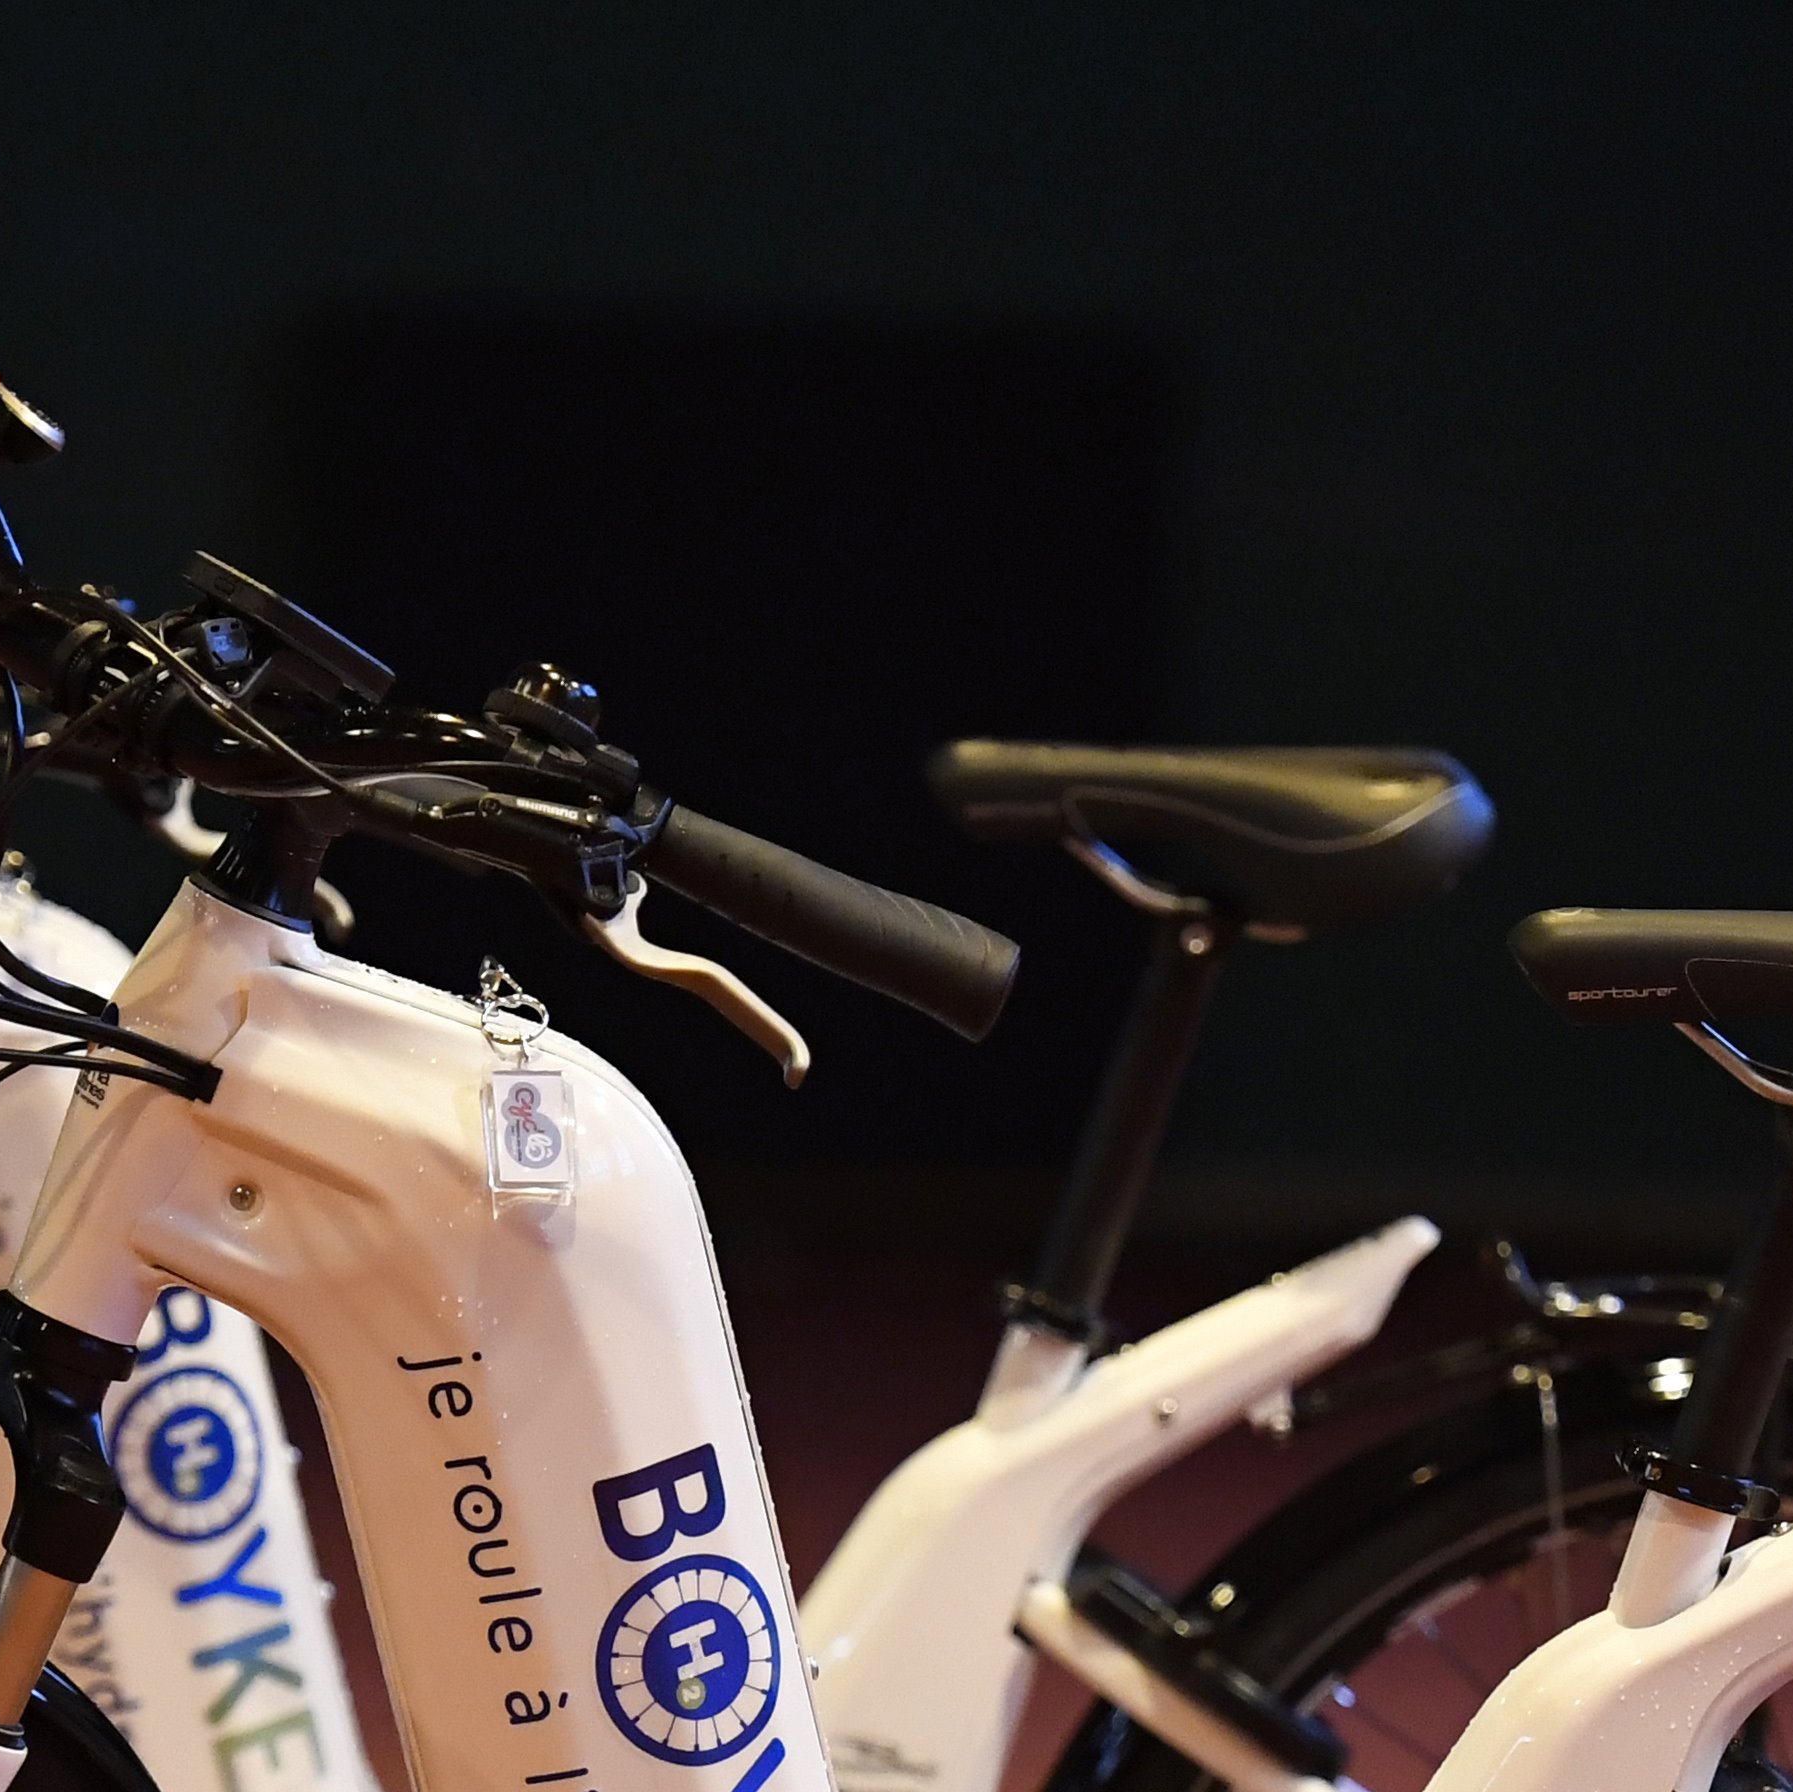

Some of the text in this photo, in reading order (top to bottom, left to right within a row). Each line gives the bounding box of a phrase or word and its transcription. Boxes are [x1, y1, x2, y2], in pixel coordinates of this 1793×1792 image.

[396, 1350, 484, 1419] je
[444, 1455, 544, 1655] roule
[507, 1691, 570, 1727] à
